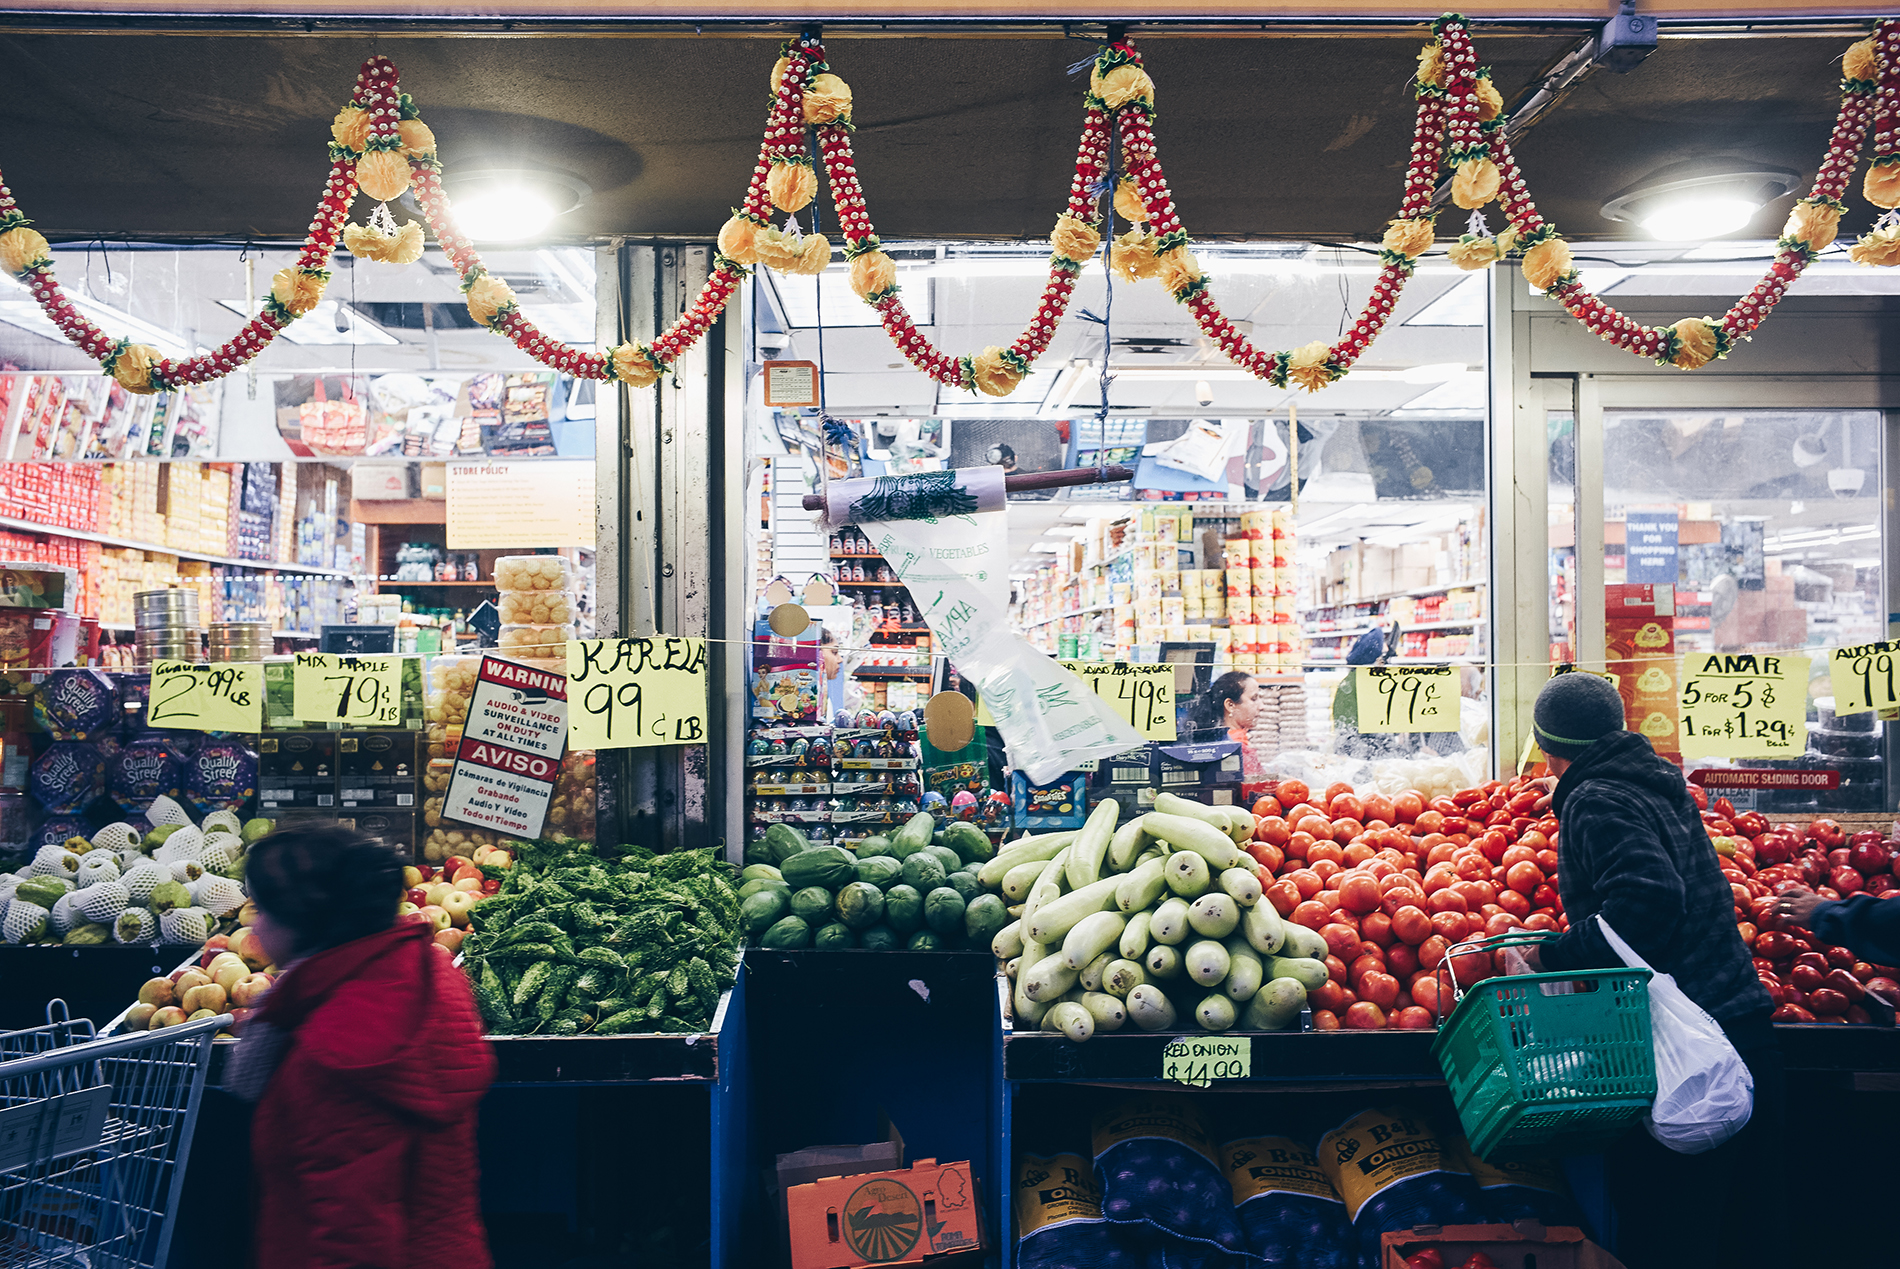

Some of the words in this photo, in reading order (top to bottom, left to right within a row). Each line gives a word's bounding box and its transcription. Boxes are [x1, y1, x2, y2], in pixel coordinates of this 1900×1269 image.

[453, 467, 478, 476] STORE
[481, 466, 509, 475] POLICY
[1627, 523, 1657, 532] THANK
[1659, 523, 1678, 532] YOU
[1643, 534, 1662, 543] FOR
[929, 542, 989, 559] VEGETABLES
[1630, 546, 1675, 555] SHOPPING
[1640, 557, 1665, 566] HERE
[297, 654, 328, 669] MIX
[571, 638, 706, 682] KARELA
[1703, 655, 1783, 675] ANAR
[57, 689, 90, 716] Street
[64, 677, 99, 710] Quality
[1682, 681, 1701, 704] 5
[1704, 693, 1728, 703] FOR
[1732, 681, 1754, 708] 5
[379, 707, 398, 722] LB
[483, 708, 559, 734] SURVEILLANCE
[486, 699, 518, 713] AUDIO
[520, 707, 528, 716] &
[530, 709, 561, 724] VIDEO
[496, 722, 512, 732] ON
[513, 725, 541, 739] DUTY
[675, 716, 703, 741] LB
[1681, 716, 1696, 736] 1
[1702, 726, 1721, 736] FOR
[482, 728, 495, 738] AT
[497, 732, 516, 743] ALL
[517, 736, 548, 751] TIMES
[40, 752, 74, 786] Quality
[123, 755, 164, 771] Quality
[199, 755, 241, 771] Quality
[471, 744, 549, 777] AVISO
[51, 760, 80, 792] Street
[126, 766, 162, 784] Street
[202, 767, 238, 784] Street
[458, 767, 494, 784] Cámaras
[496, 778, 506, 788] de
[508, 780, 549, 798] Vigilancia
[1704, 773, 1759, 784] AUTOMATIC
[1760, 773, 1800, 785] SLIDING
[1801, 774, 1829, 785] DOOR
[477, 786, 520, 804] Grabando
[468, 796, 494, 811] Audio
[494, 803, 501, 812] Y
[503, 806, 528, 819] Video
[462, 807, 483, 821] Todo
[484, 814, 494, 823] el
[494, 815, 528, 832] Tiempo
[1164, 1043, 1190, 1058] RED
[1193, 1044, 1239, 1057] ONION
[1367, 1117, 1421, 1146] B&B
[1369, 1140, 1441, 1166] ONIONS
[1261, 1167, 1327, 1183] ONION
[878, 1191, 908, 1202] Desert
